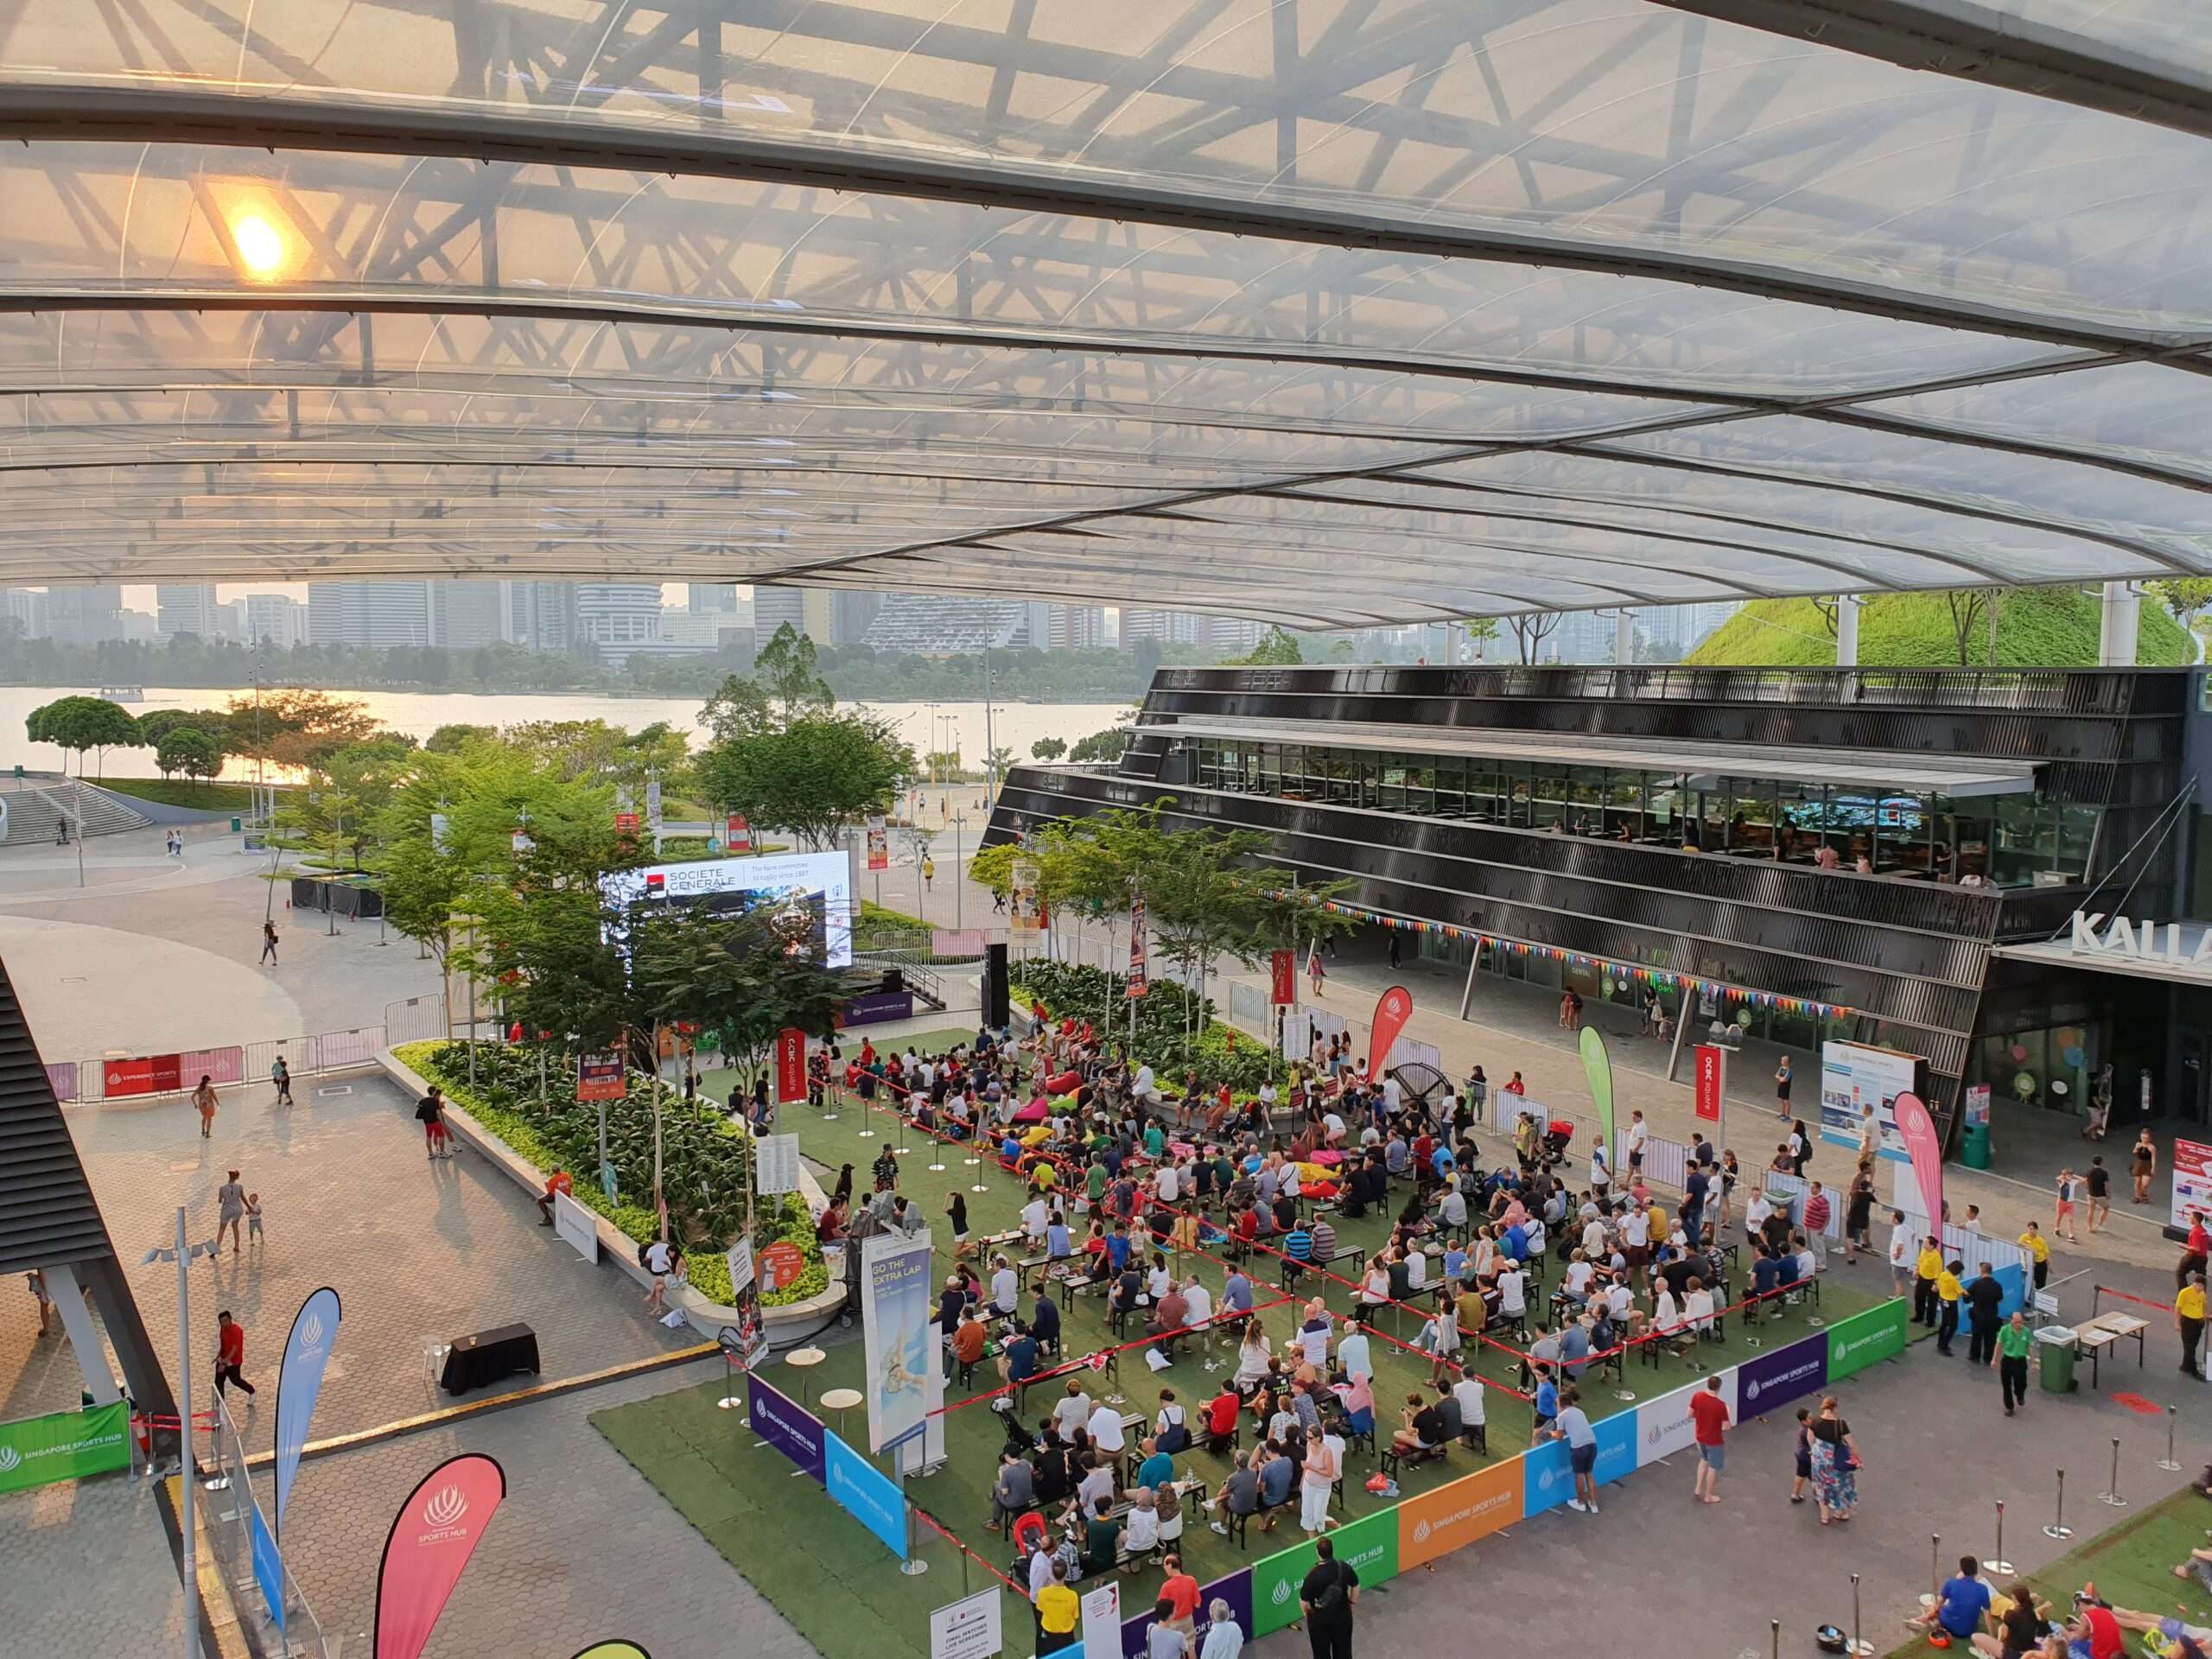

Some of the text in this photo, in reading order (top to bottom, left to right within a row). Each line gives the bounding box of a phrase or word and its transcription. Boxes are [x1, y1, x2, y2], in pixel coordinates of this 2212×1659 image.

[670, 868, 723, 880] SOCIETE
[670, 876, 735, 891] GENERALE
[124, 1072, 156, 1081] EXPERIENCE
[873, 1258, 906, 1275] GO THE
[873, 1265, 921, 1286] EXTRA LAP
[1847, 1336, 1872, 1351] SINGAPORE
[1872, 1329, 1889, 1341] SPORTS
[1761, 1360, 1820, 1389] SINGAPORE SPORTS HUB
[767, 1410, 816, 1452] SINGAPORE SPORTS HUB
[24, 1433, 123, 1459] SINGAPORE SPORTS HUB
[1433, 1491, 1512, 1529] SINGAPORE SPORTS HUB
[418, 1531, 449, 1543] SPORTS
[449, 1528, 467, 1537] HUB
[1348, 1545, 1384, 1567] ORTS HUB
[945, 1629, 988, 1650] LIVE SCREENING
[963, 1623, 987, 1637] MATCHES
